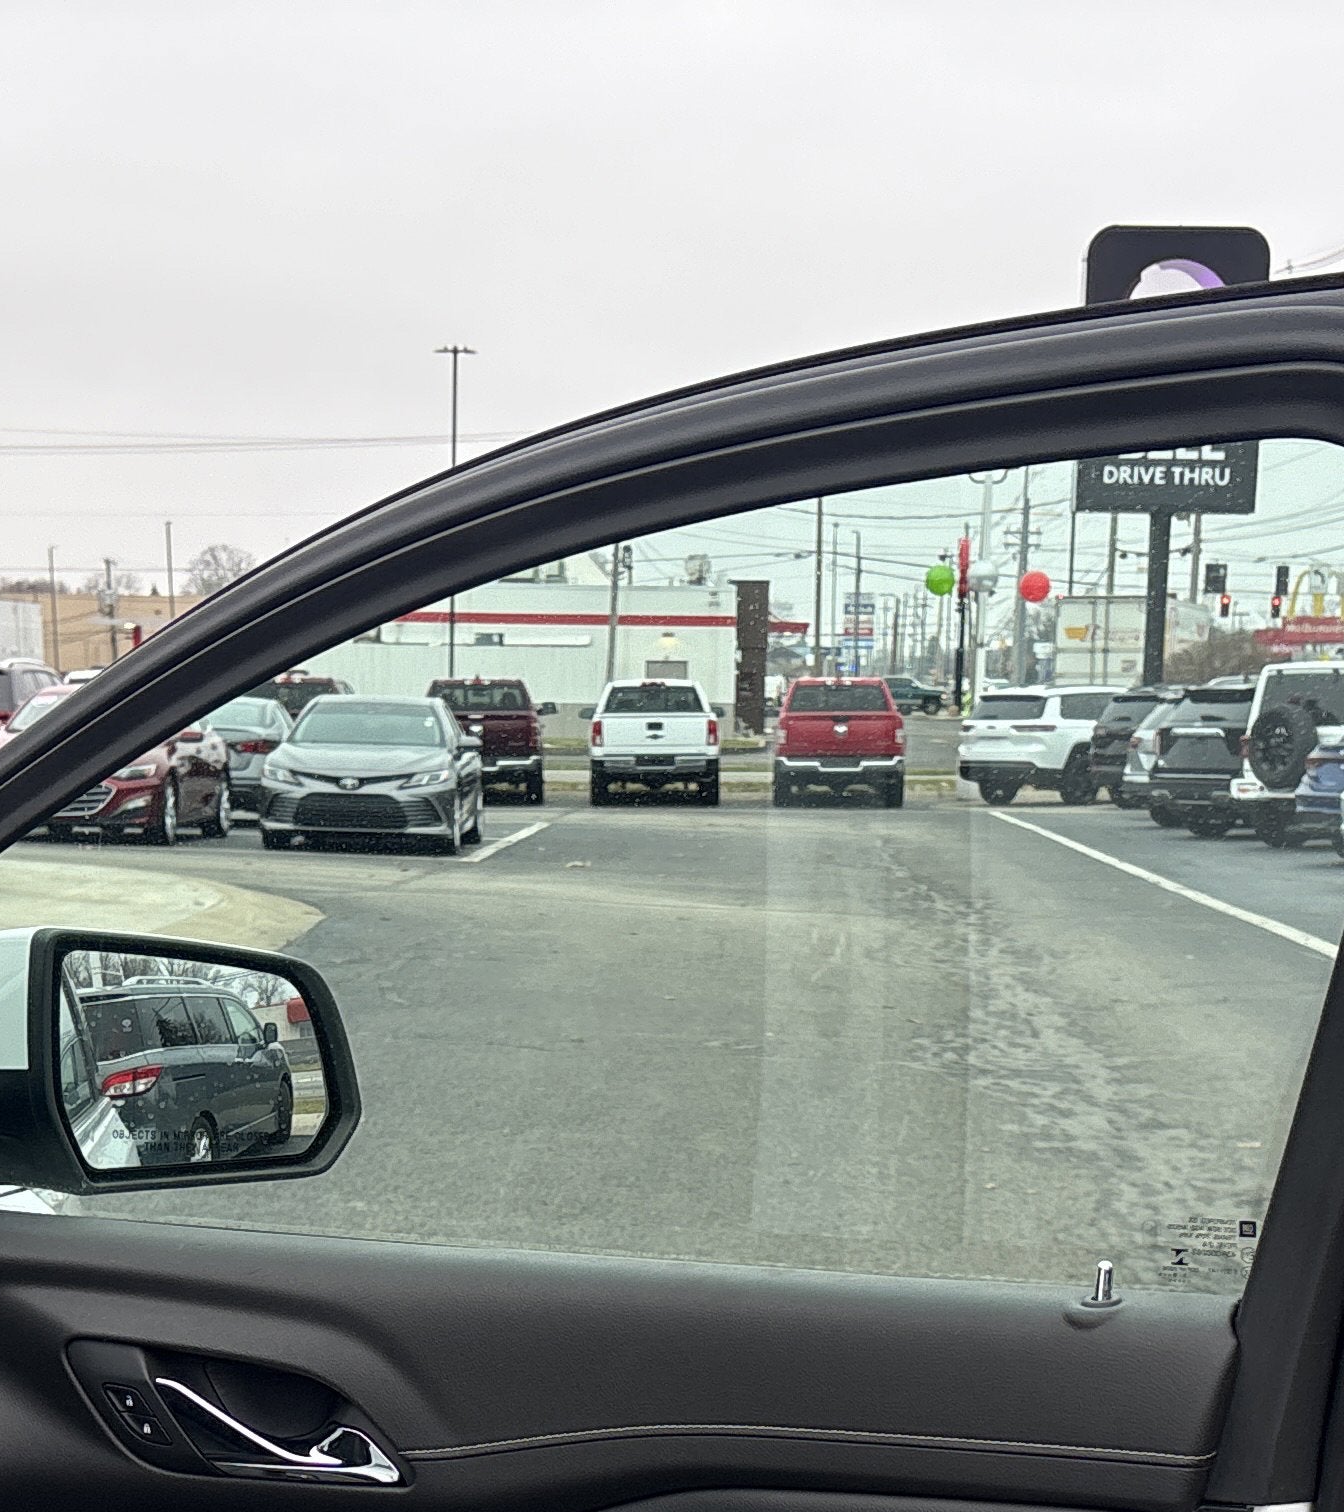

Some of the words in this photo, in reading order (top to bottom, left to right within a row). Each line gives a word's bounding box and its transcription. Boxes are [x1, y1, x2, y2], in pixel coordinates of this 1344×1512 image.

[1103, 465, 1167, 485] DRIVE
[1171, 466, 1231, 486] THRU
[111, 1128, 157, 1141] OBJECTS
